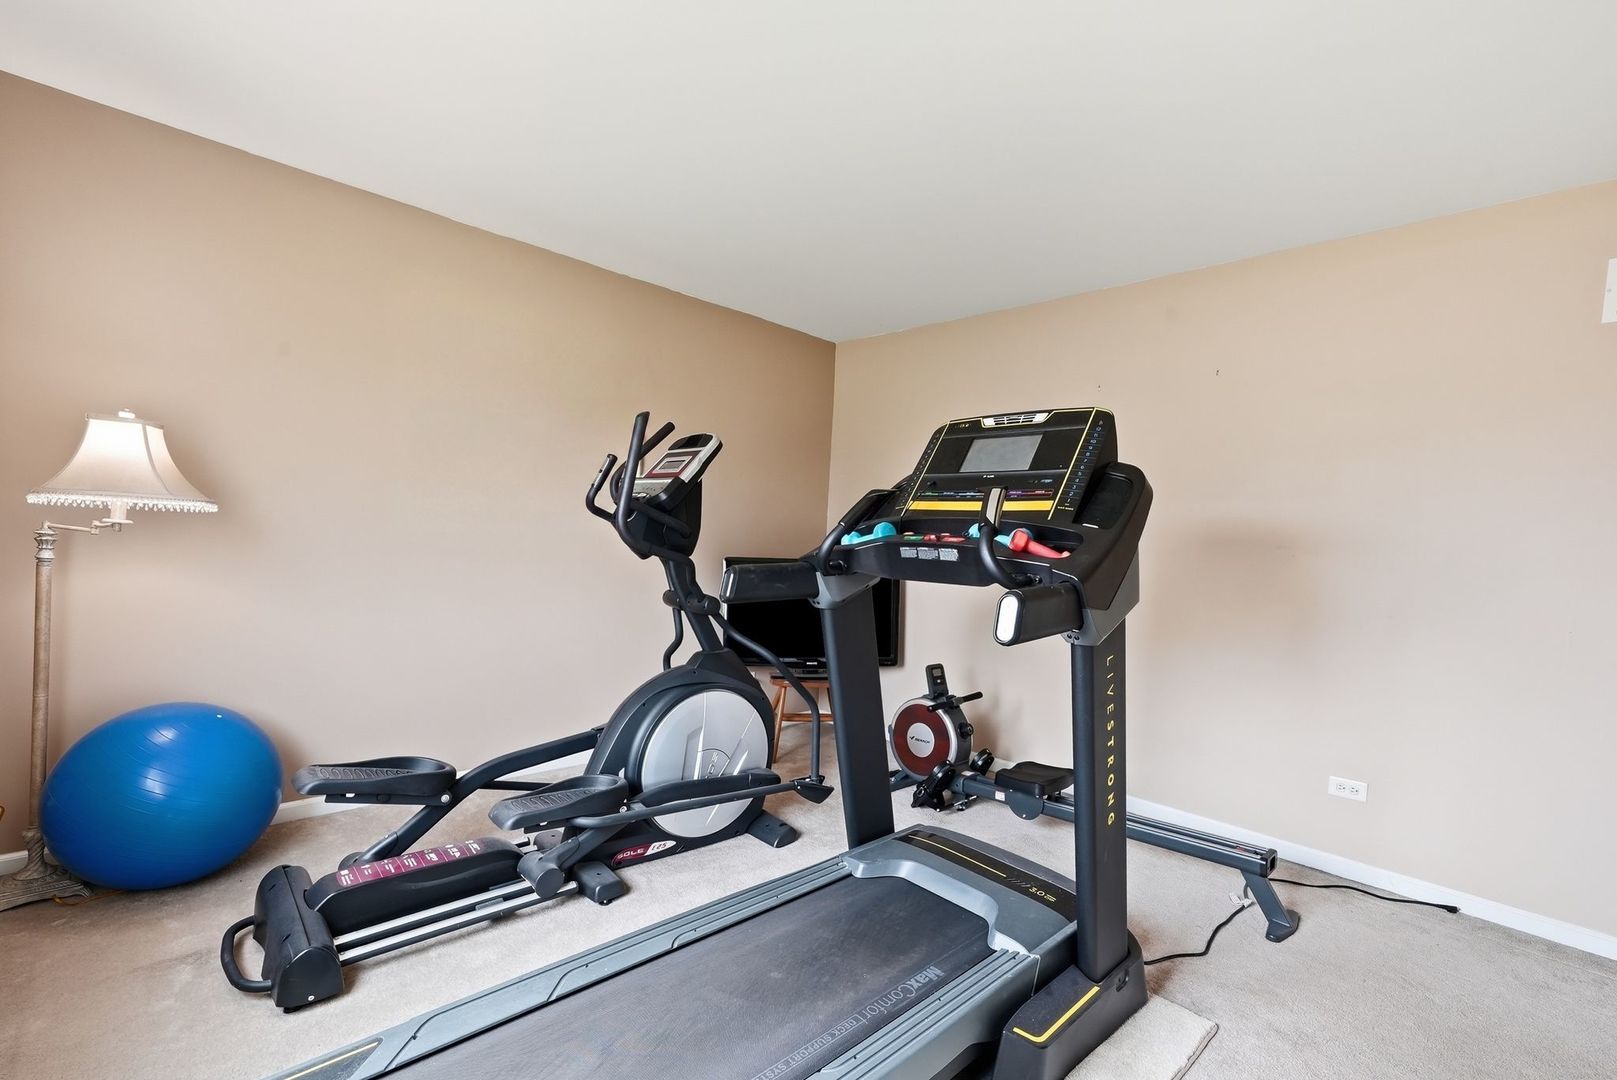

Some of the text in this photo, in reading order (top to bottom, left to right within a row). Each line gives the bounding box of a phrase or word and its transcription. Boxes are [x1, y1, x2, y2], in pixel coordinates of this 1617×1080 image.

[1106, 654, 1115, 826] LIVESTRONG
[616, 848, 645, 859] SOLE
[1028, 886, 1045, 897] 3.0
[860, 965, 945, 1026] MaxComfort
[833, 1019, 858, 1037] DECK
[788, 1033, 833, 1067] SUPPORT
